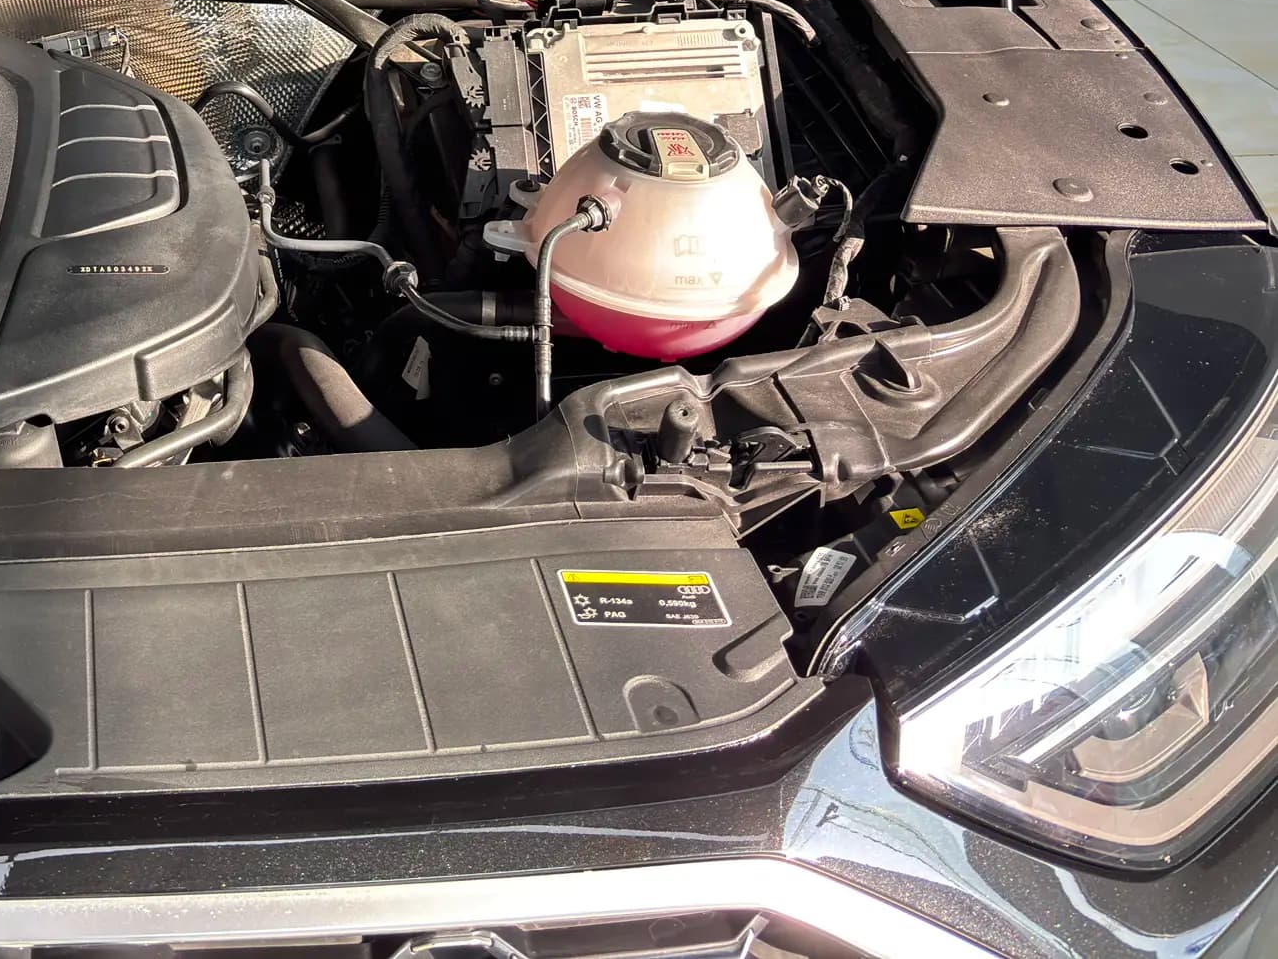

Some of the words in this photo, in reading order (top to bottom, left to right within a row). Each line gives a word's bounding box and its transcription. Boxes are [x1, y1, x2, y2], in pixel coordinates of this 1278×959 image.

[593, 95, 602, 109] VW
[571, 106, 579, 126] BOSCH
[595, 111, 603, 123] AG
